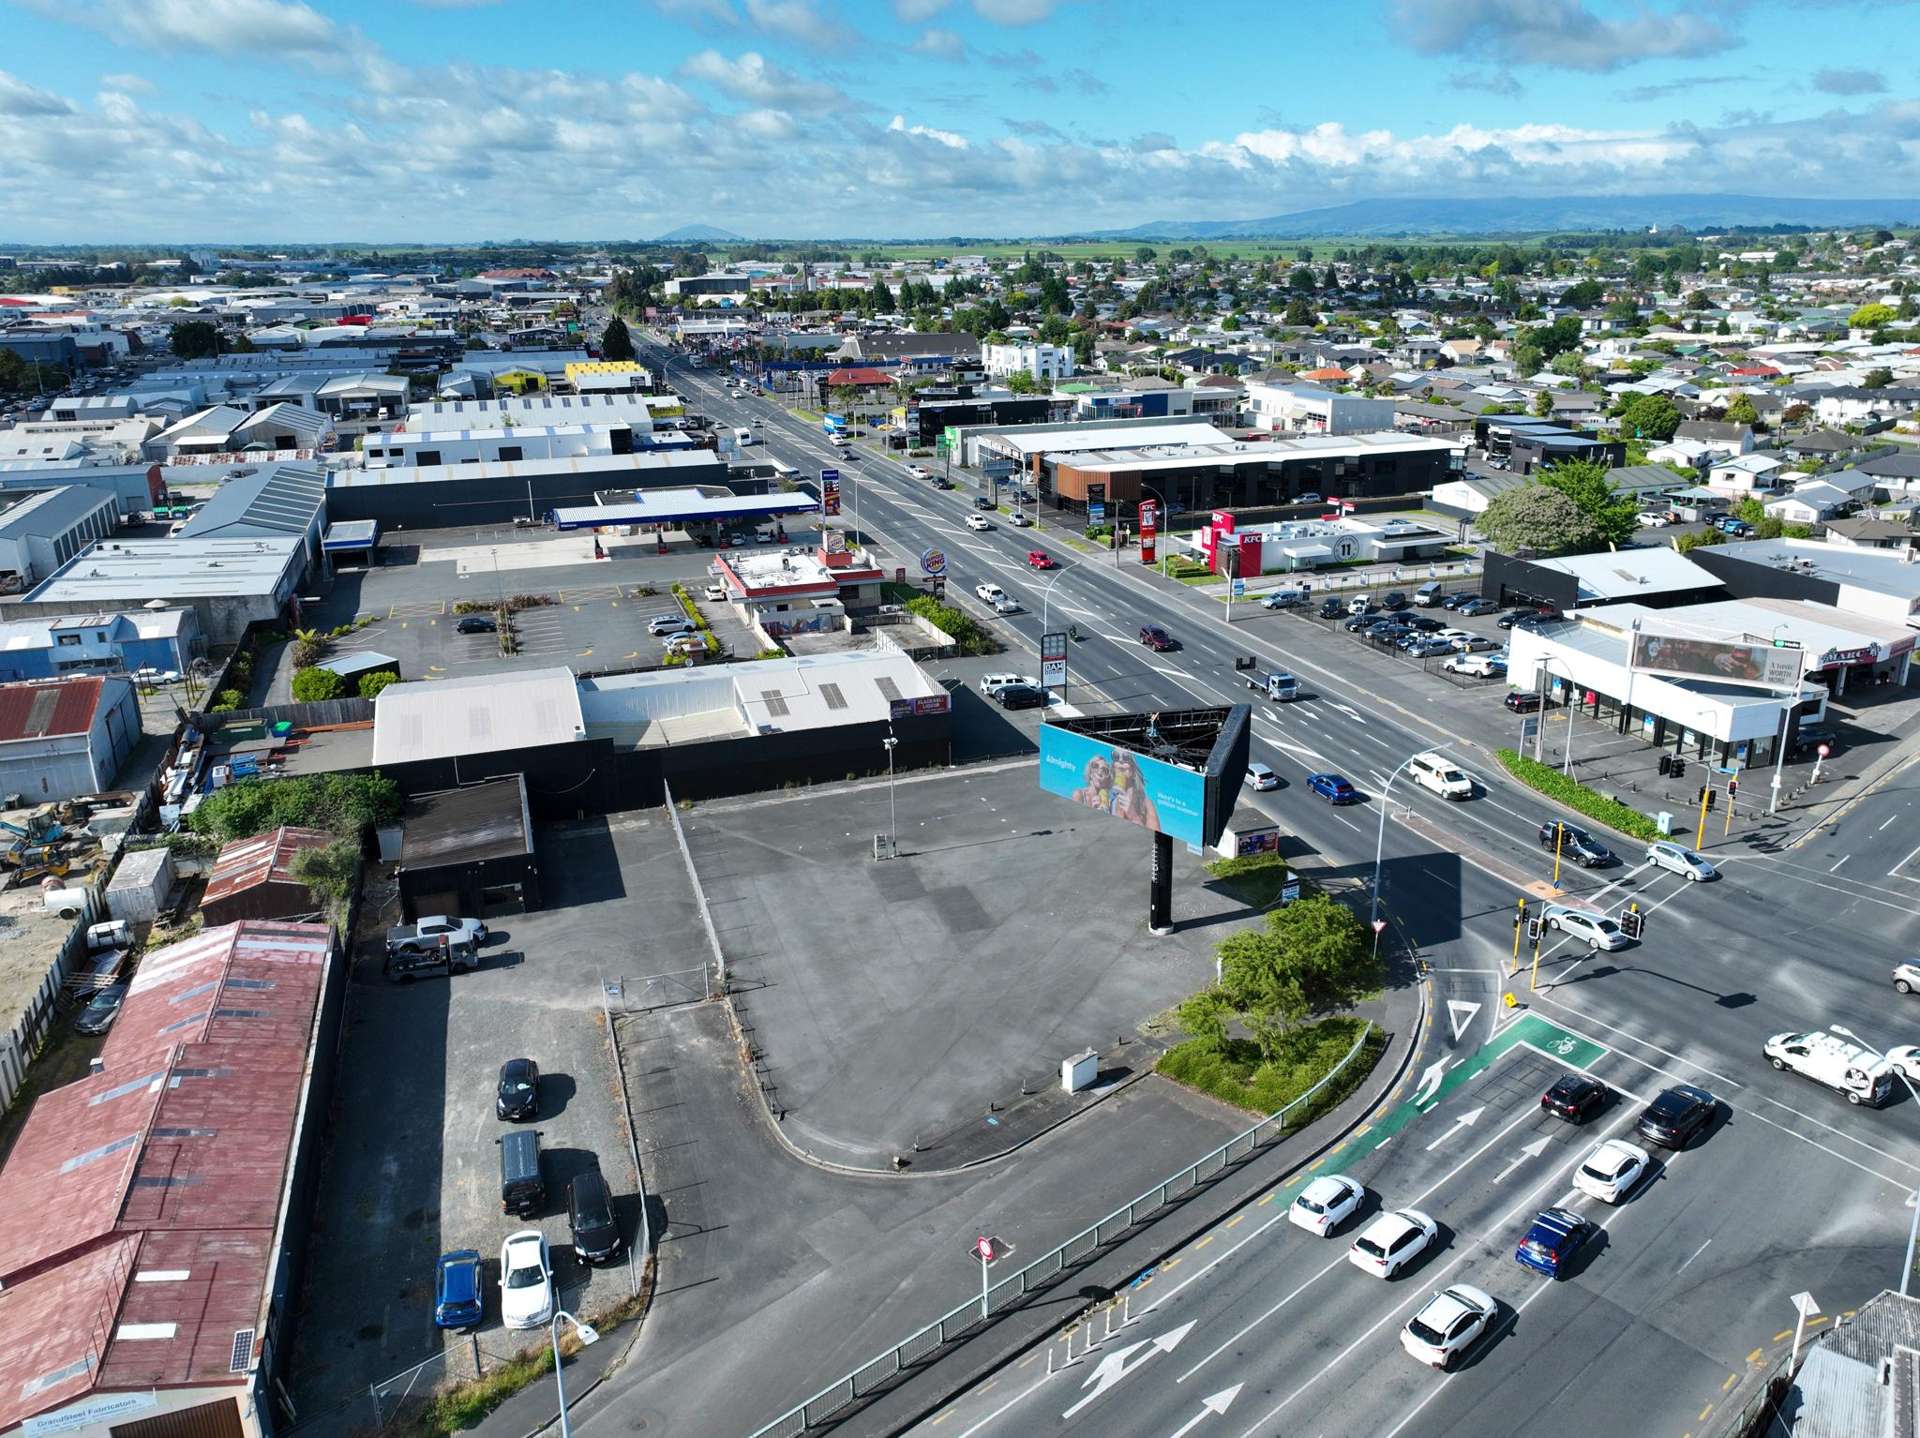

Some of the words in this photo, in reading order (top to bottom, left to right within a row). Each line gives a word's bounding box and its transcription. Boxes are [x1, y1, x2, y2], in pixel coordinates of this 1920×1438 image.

[1212, 513, 1224, 524] KFC
[1243, 534, 1262, 544] KFC
[1341, 544, 1351, 556] 11
[927, 558, 945, 569] KING
